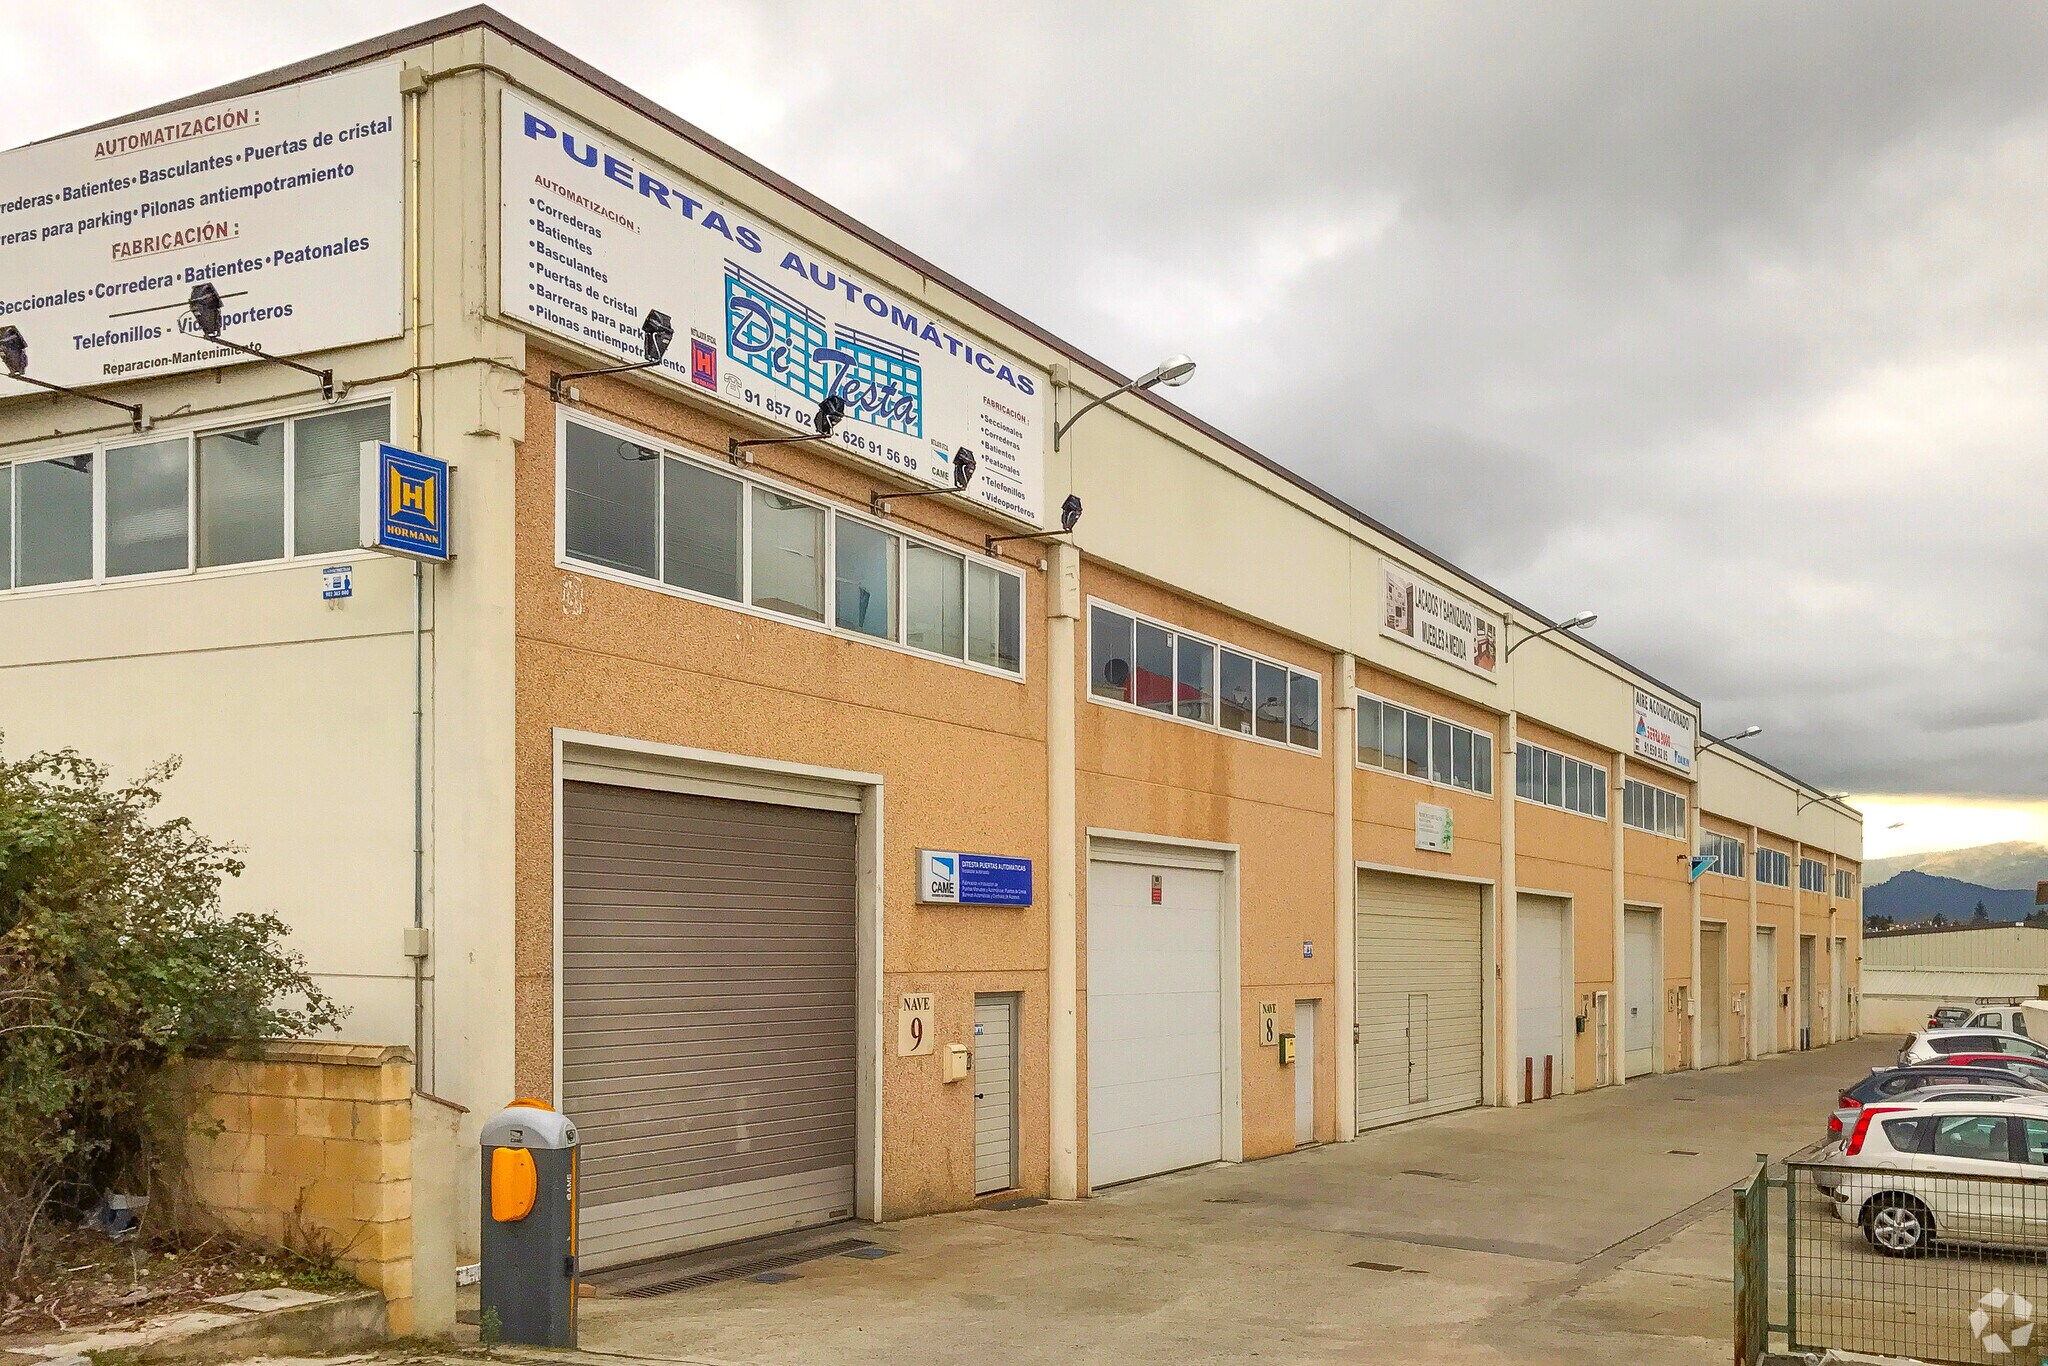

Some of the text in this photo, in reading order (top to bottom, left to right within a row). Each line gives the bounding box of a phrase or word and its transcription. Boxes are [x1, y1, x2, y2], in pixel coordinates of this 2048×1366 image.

[94, 108, 249, 157] AUTOMATIZACIÓN
[0, 116, 393, 214] rederas Batientes Basculantes Puertas de cristal
[523, 111, 762, 253] PUERTAS
[0, 162, 355, 246] reras para parking Pilonas antiempotramiento
[534, 174, 635, 231] AUTOMATIZACIÓN
[537, 198, 602, 238] Correderas
[112, 220, 229, 260] FABRICACIÓN
[537, 219, 593, 256] Batientes
[0, 236, 370, 316] Seccionales Corredera Batientes Peatonales
[537, 241, 608, 283] Basculantes
[537, 262, 637, 317] Puertas de cristal
[72, 325, 162, 350] Telefonillos
[177, 304, 293, 333] Viporteros
[537, 284, 644, 341] Barreras para park
[780, 252, 1035, 396] AUTOMÁTICAS
[536, 305, 579, 331] Pilonas
[583, 325, 686, 374] antiempotrento
[730, 296, 917, 425] Di Testa
[744, 389, 761, 406] 91
[766, 398, 791, 418] 857
[795, 410, 812, 427] 02
[842, 431, 865, 449] 626
[869, 441, 882, 456] 91
[887, 449, 901, 464] 56
[904, 455, 917, 470] 99
[983, 396, 1026, 423] FABRICACIÓN
[984, 414, 1023, 439] Seccionales
[984, 428, 1020, 451] Correderas
[984, 441, 1015, 462] Batientes
[984, 455, 1021, 476] Peatonales
[402, 481, 422, 510] H
[986, 476, 1026, 500] Telefonillos
[986, 492, 1035, 519] Videoporteros
[931, 881, 955, 894] CAME
[903, 997, 930, 1011] NAVE
[911, 1017, 923, 1051] 9
[1266, 1017, 1273, 1042] 8
